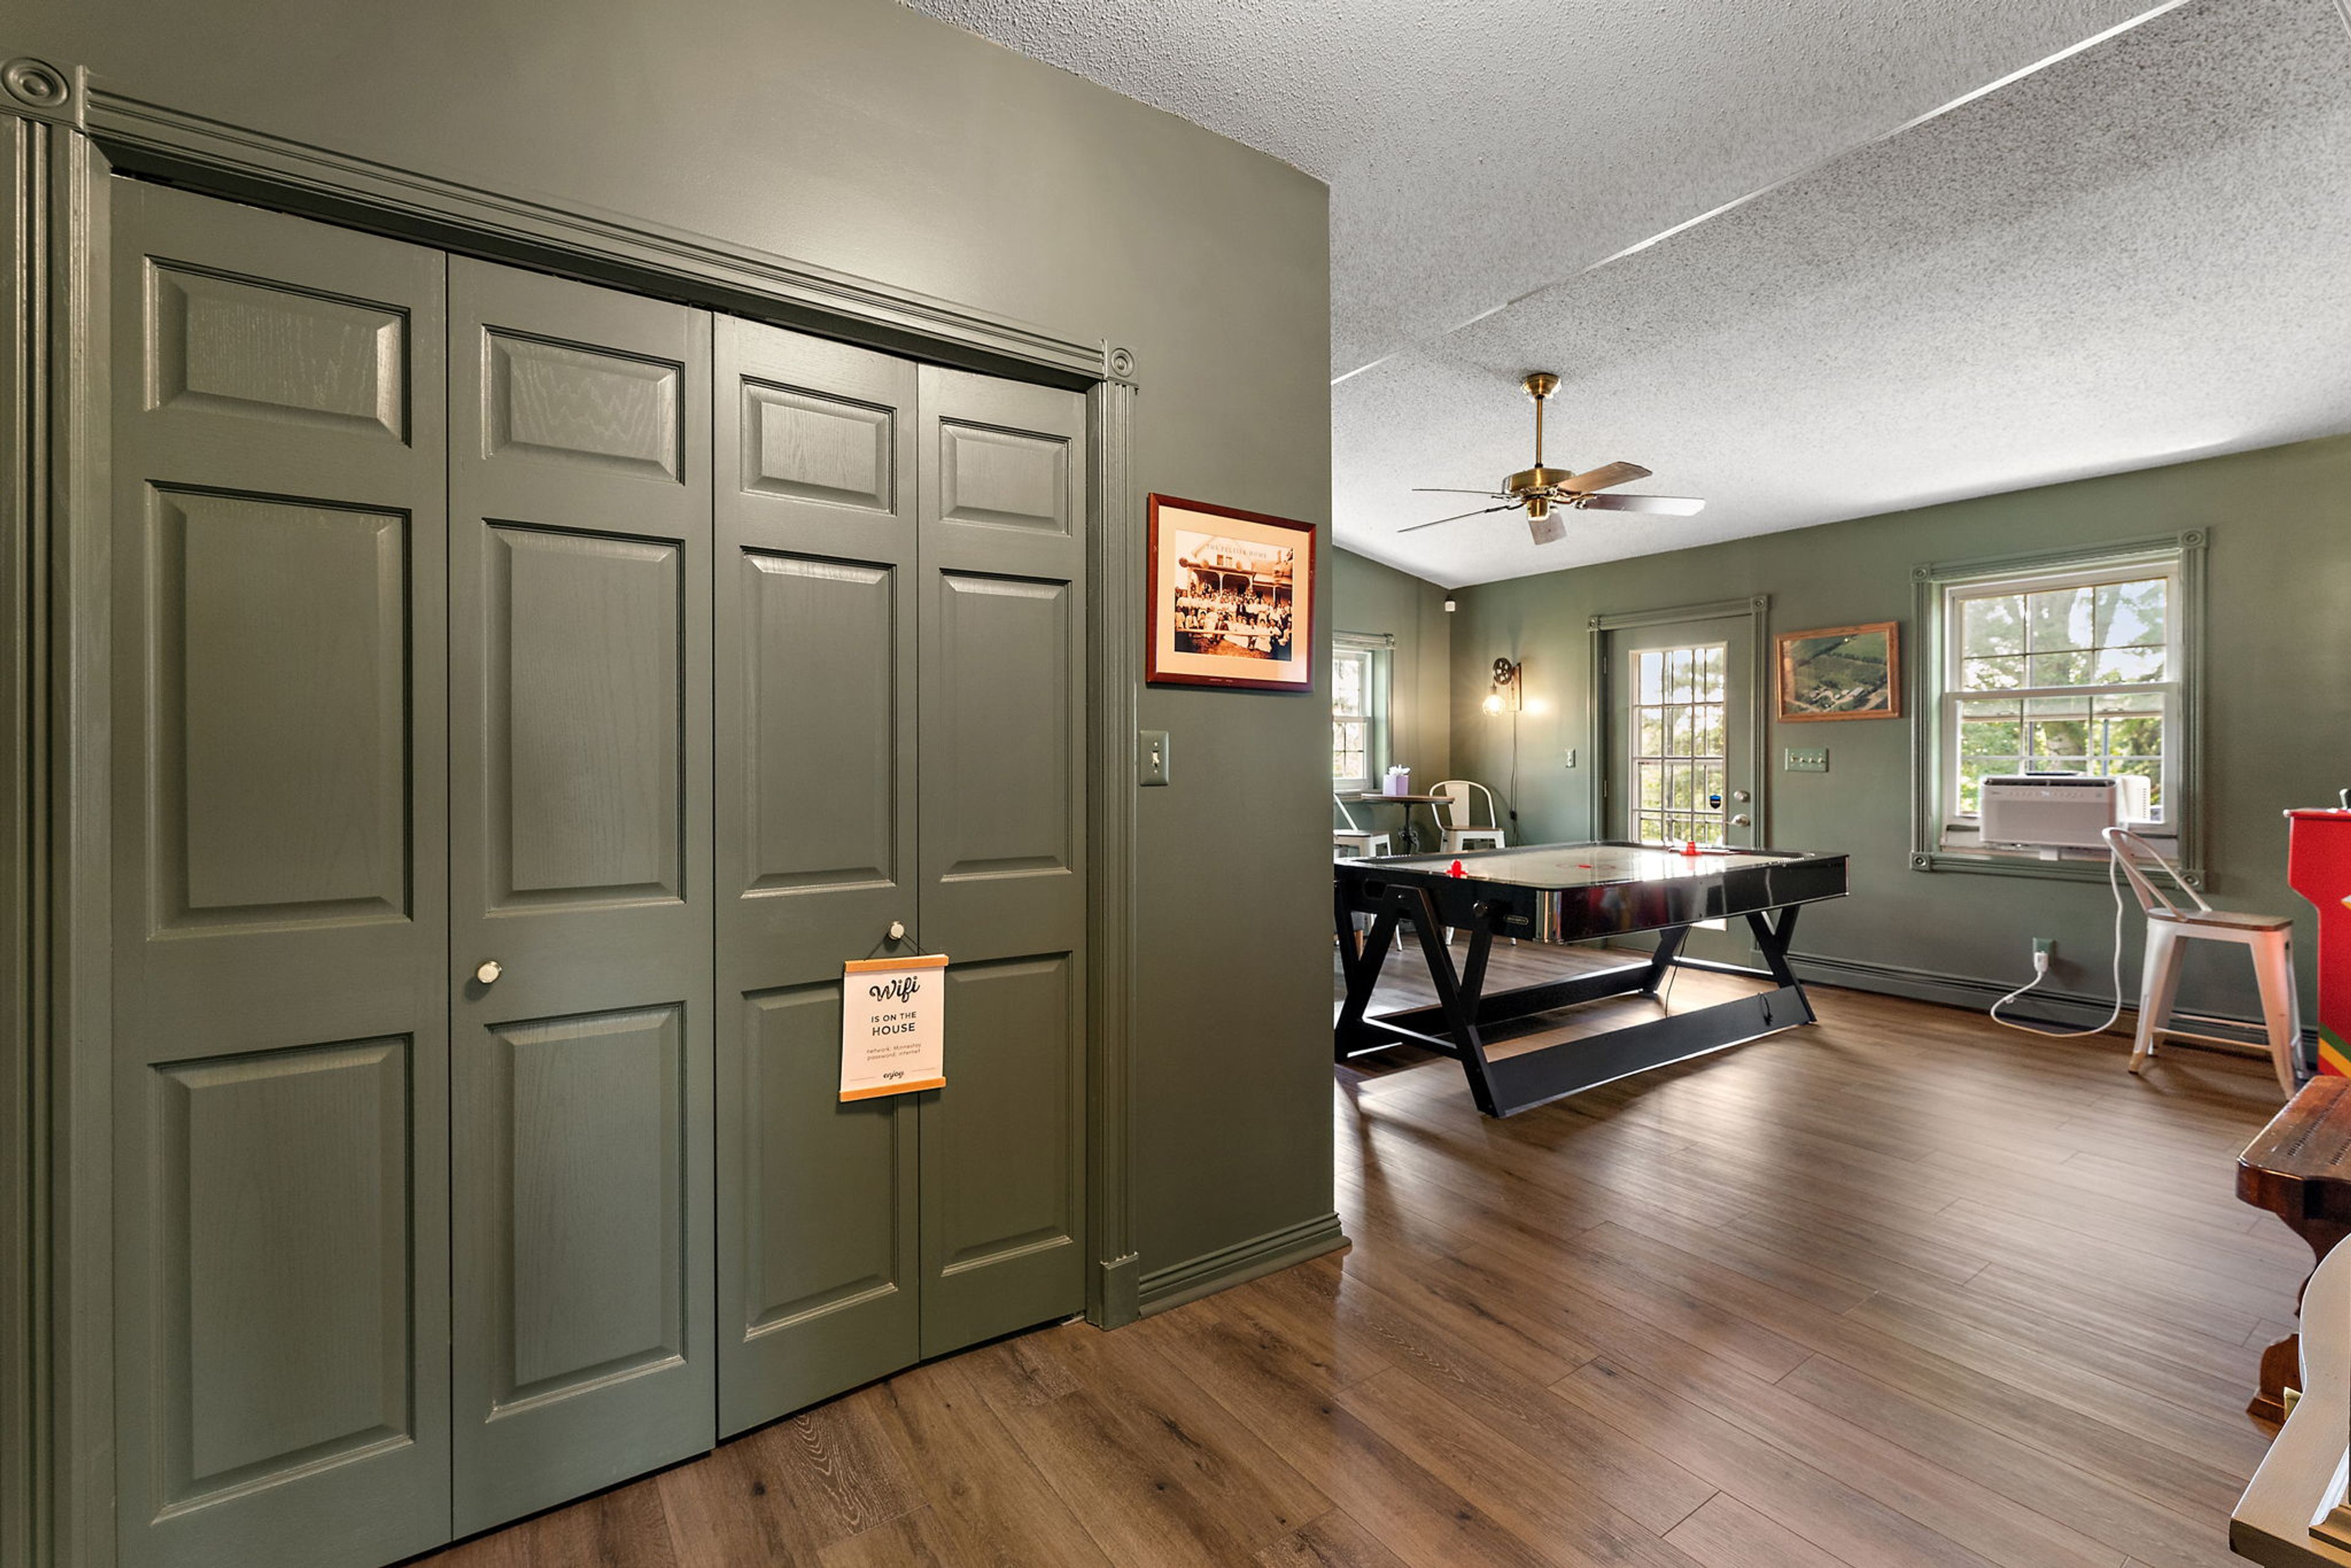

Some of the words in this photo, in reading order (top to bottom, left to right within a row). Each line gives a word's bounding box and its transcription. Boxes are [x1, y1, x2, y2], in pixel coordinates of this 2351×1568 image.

[869, 975, 920, 1003] Wifi
[900, 1011, 917, 1019] THE
[872, 1022, 915, 1036] HOUSE
[883, 1070, 904, 1080] enjoy
